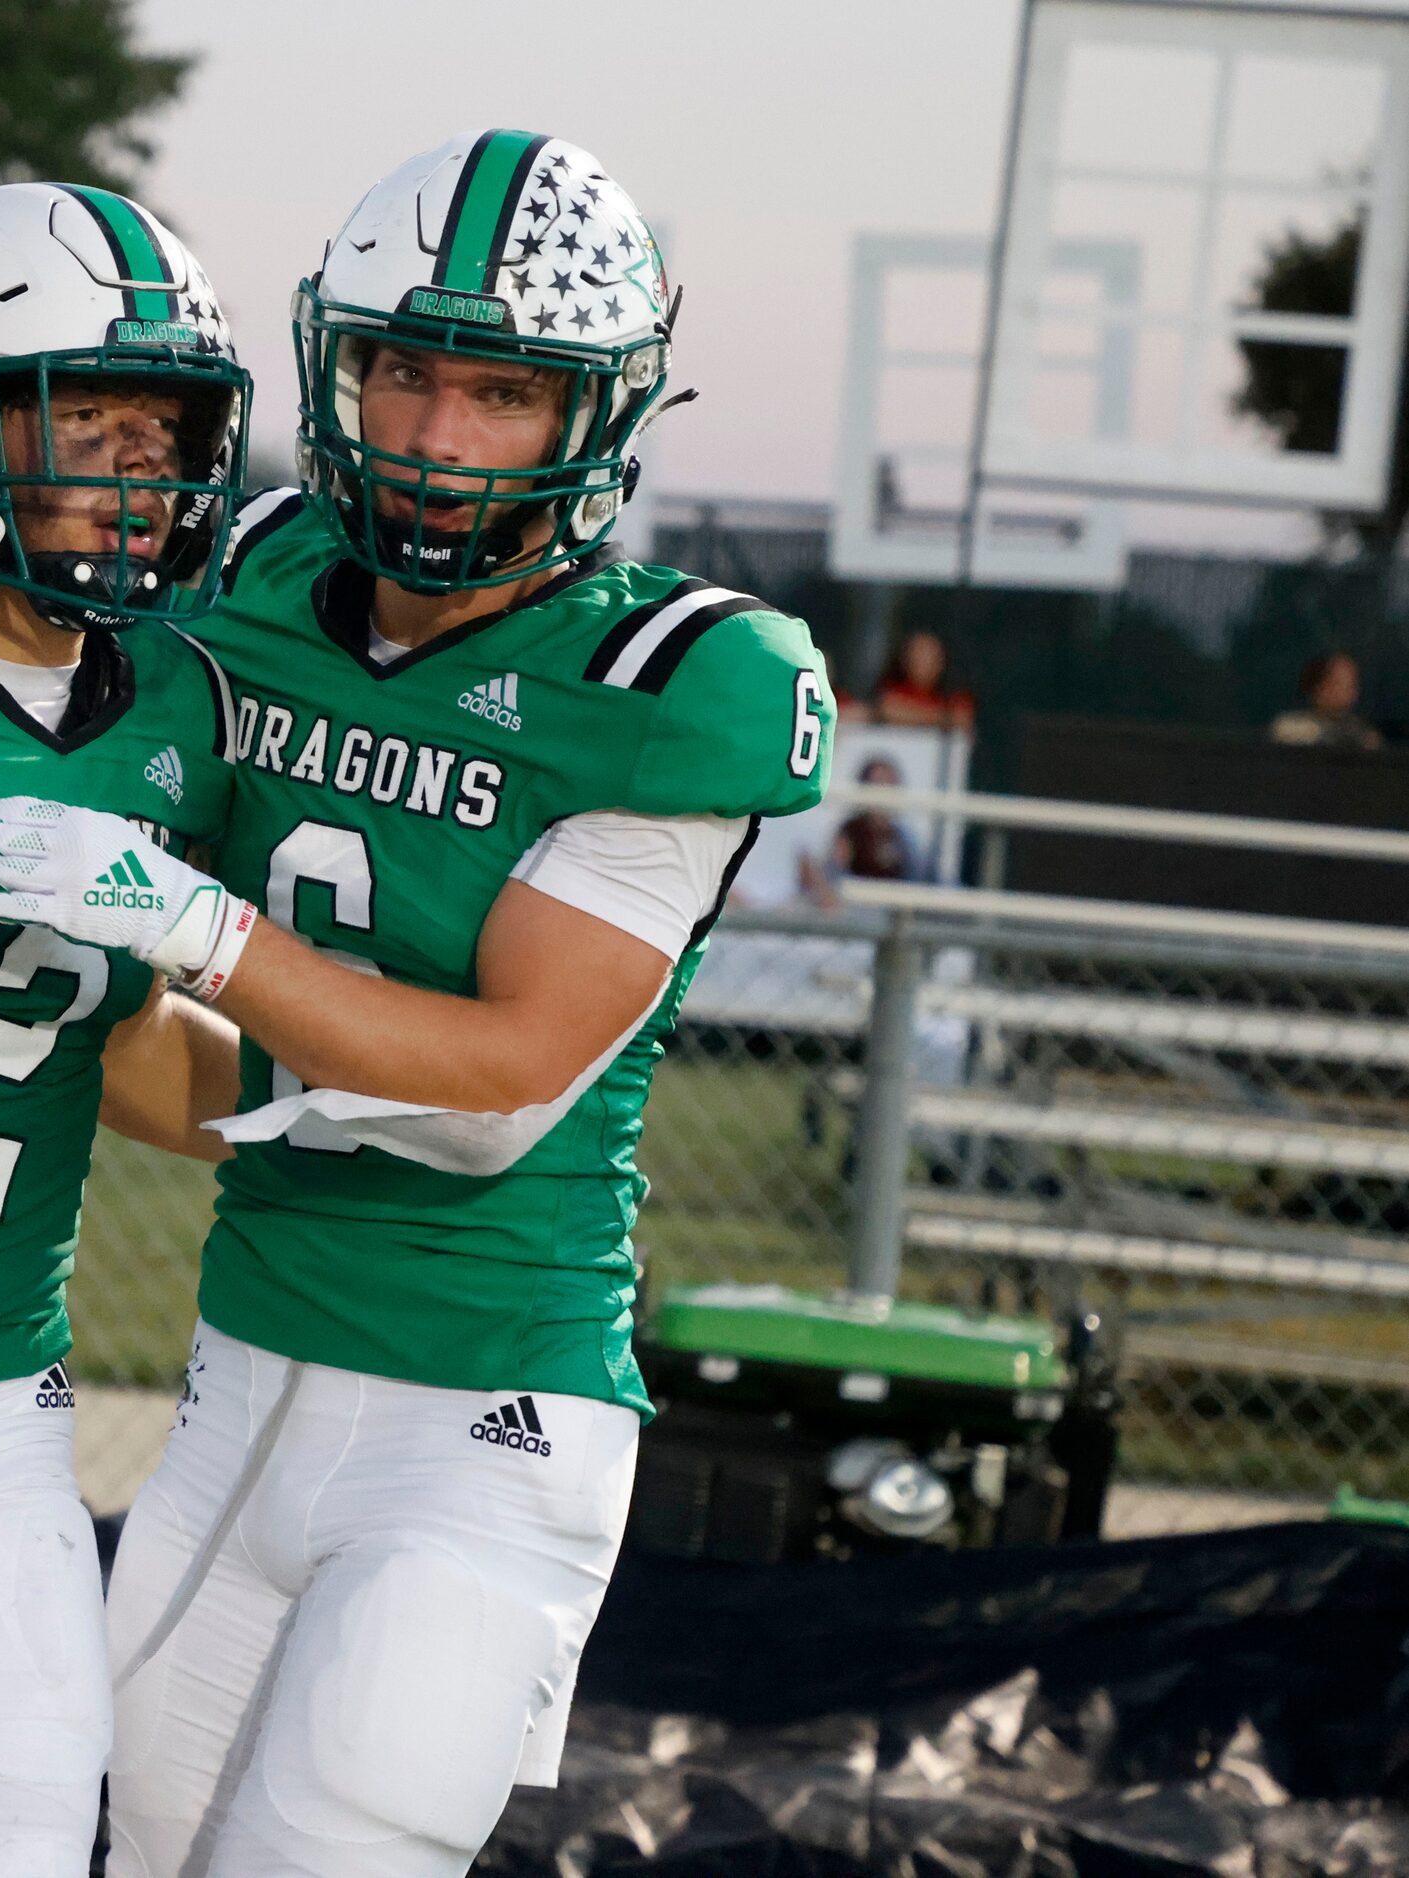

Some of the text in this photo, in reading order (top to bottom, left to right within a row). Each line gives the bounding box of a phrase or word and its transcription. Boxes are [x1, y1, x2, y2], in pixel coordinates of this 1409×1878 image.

[409, 290, 505, 325] DRAGONS
[116, 321, 198, 344] DRAGONS
[458, 690, 522, 732] adidas
[787, 669, 823, 779] 6
[235, 697, 506, 830] DRAGONS
[144, 765, 183, 805] adidas
[84, 885, 164, 911] adidas
[35, 1388, 75, 1408] adida
[470, 1422, 552, 1457] adidas
